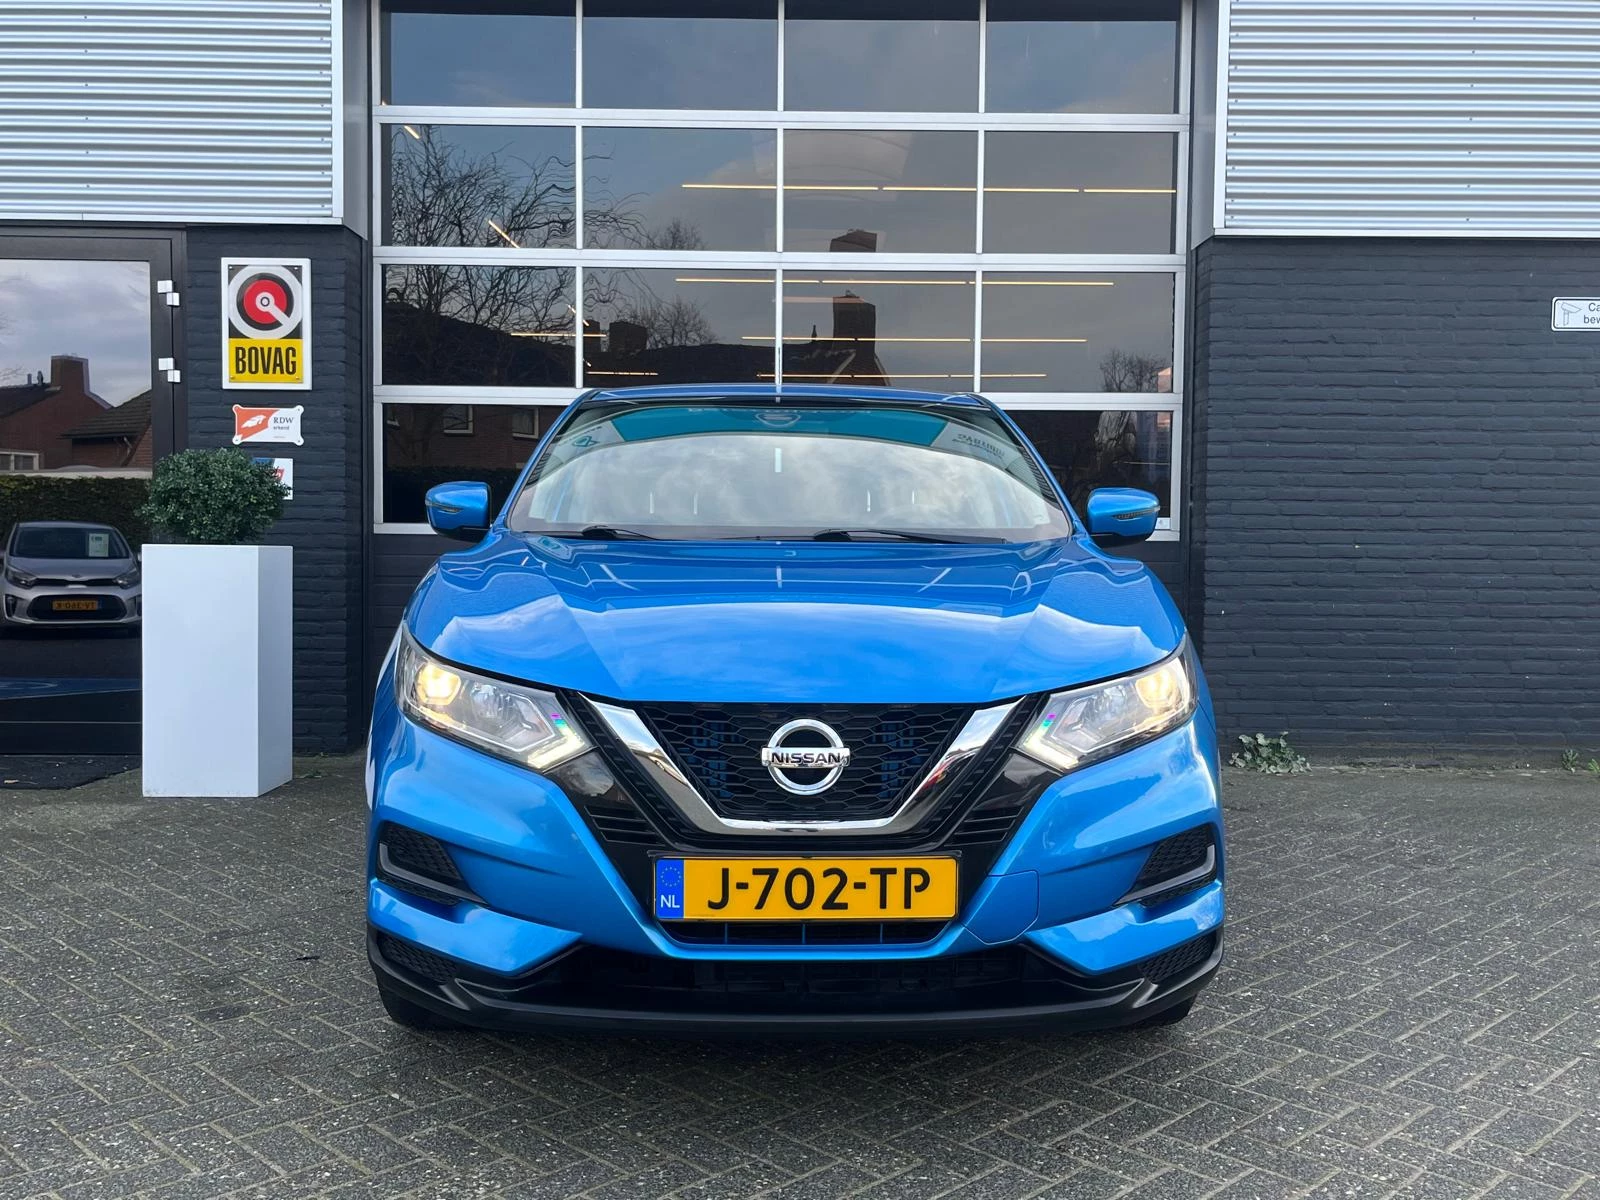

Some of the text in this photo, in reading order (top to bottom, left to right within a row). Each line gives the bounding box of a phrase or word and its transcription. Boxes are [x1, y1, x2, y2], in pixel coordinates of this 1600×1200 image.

[1588, 302, 1600, 312] Ca
[235, 346, 297, 375] BOVAG
[273, 416, 295, 424] RDW
[771, 752, 840, 764] NISSAN
[707, 867, 931, 911] J-702-TP
[660, 894, 680, 909] NL
